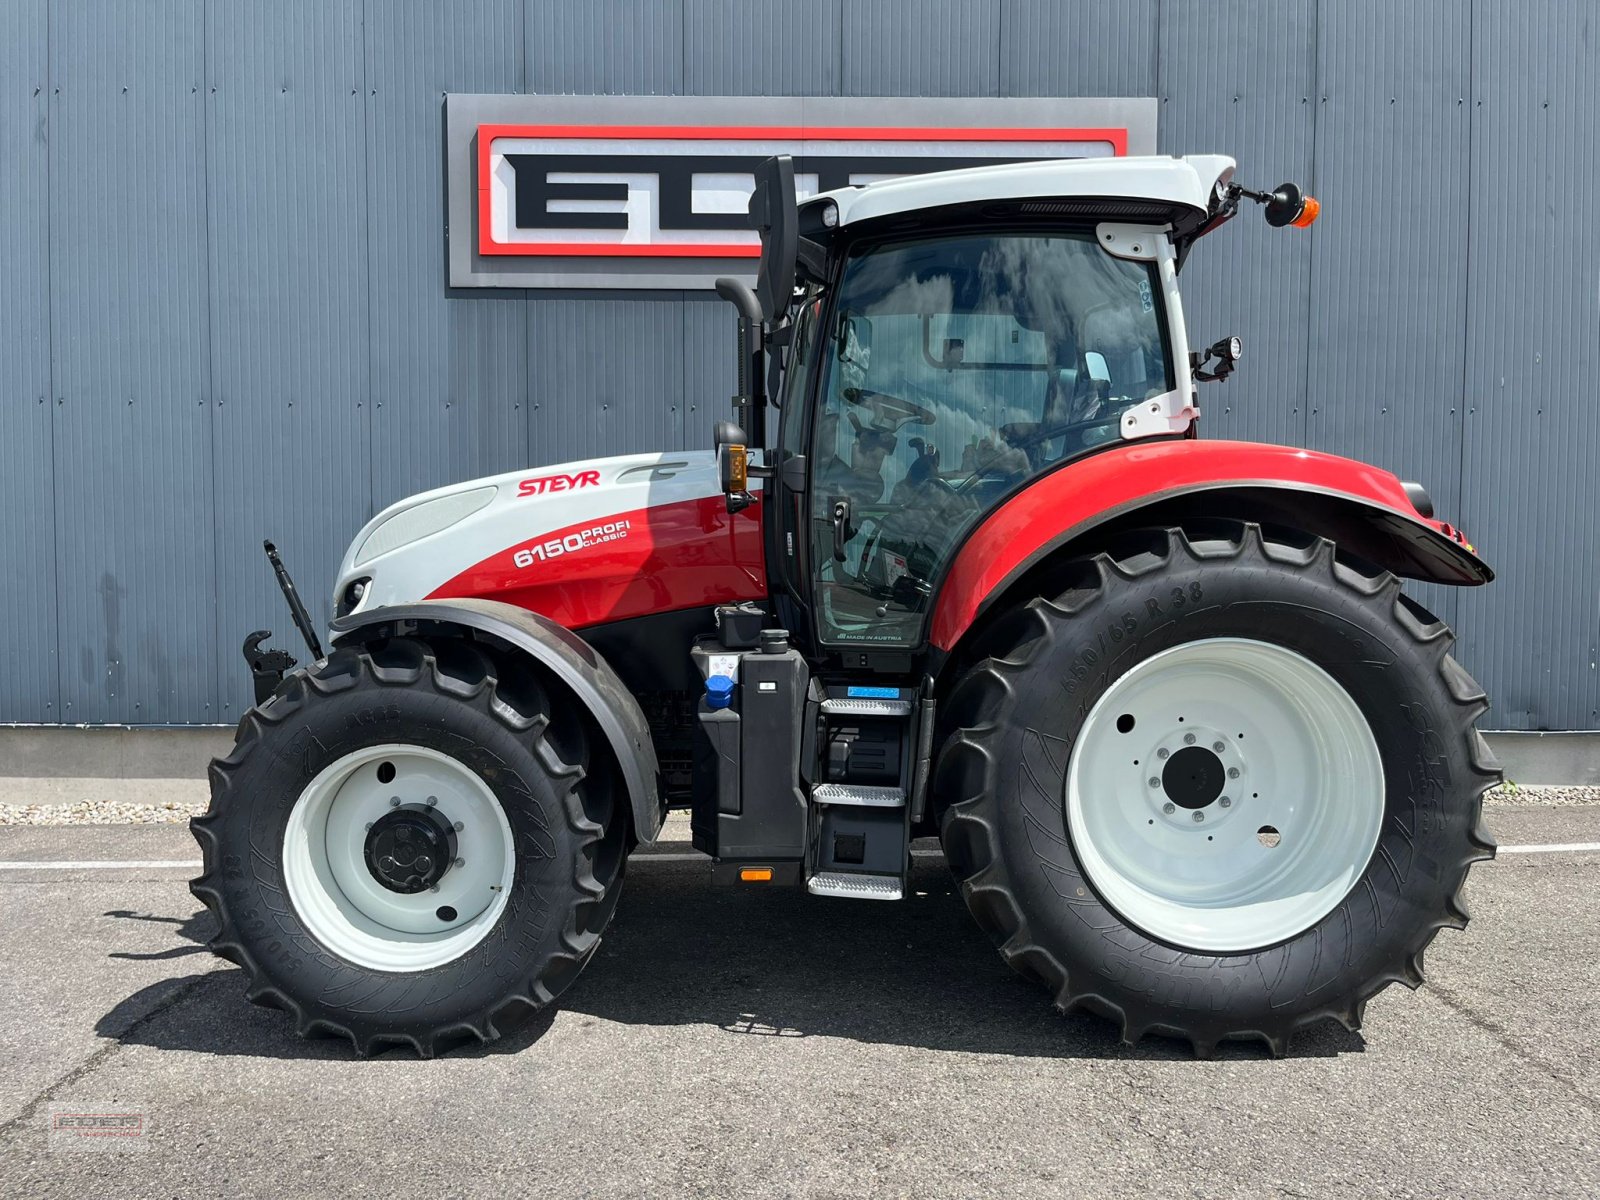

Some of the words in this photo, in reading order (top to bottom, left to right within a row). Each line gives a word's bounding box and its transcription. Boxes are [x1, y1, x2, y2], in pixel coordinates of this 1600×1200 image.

[503, 154, 1088, 230] ED
[516, 470, 600, 498] STEYR
[513, 533, 584, 568] 6150
[581, 520, 631, 539] PROFI
[583, 531, 628, 548] CLASSIC
[1061, 611, 1137, 693] 650/65
[1144, 597, 1165, 618] R
[1171, 581, 1203, 608] 38
